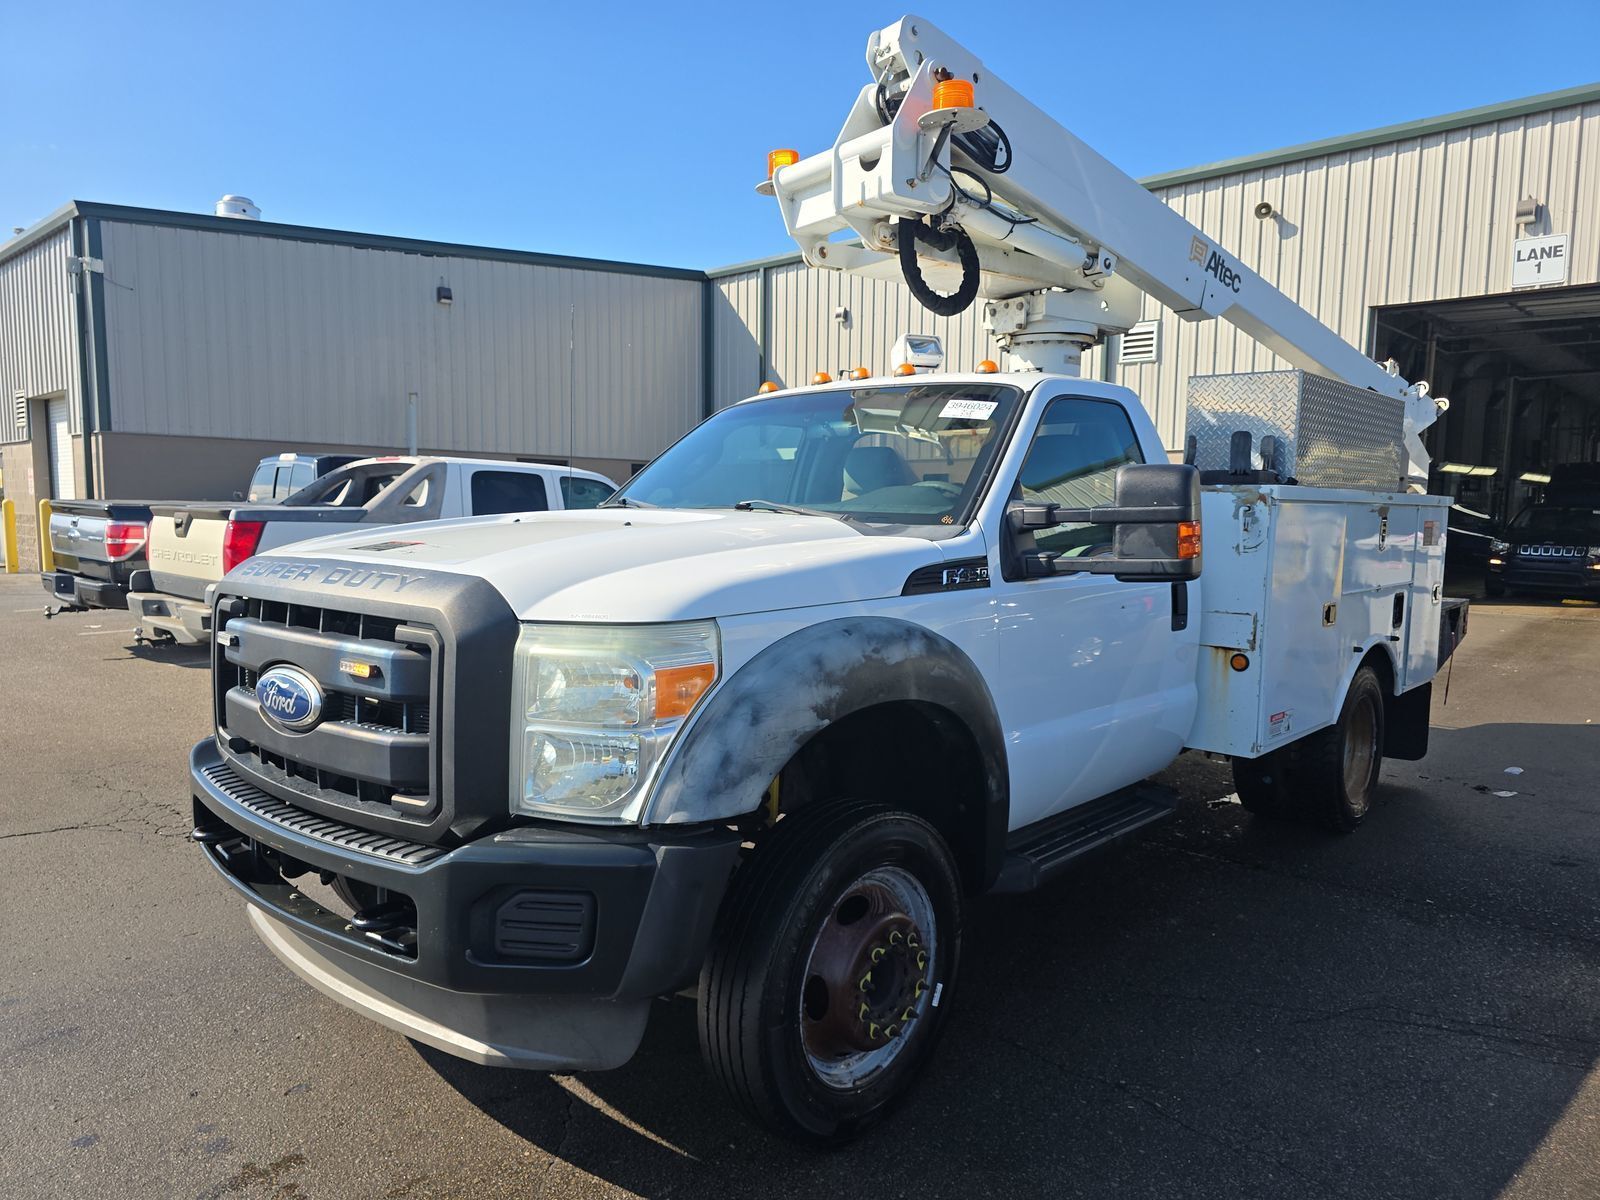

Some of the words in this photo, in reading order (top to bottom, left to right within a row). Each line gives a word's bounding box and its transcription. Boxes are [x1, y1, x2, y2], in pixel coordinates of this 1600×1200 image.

[1516, 244, 1564, 262] LANE
[1204, 250, 1241, 293] Altec
[1534, 261, 1542, 274] 1
[152, 548, 218, 566] CHEVROLET
[241, 560, 321, 582] SUPER
[320, 567, 426, 592] DUTY
[263, 678, 297, 715] Ford
